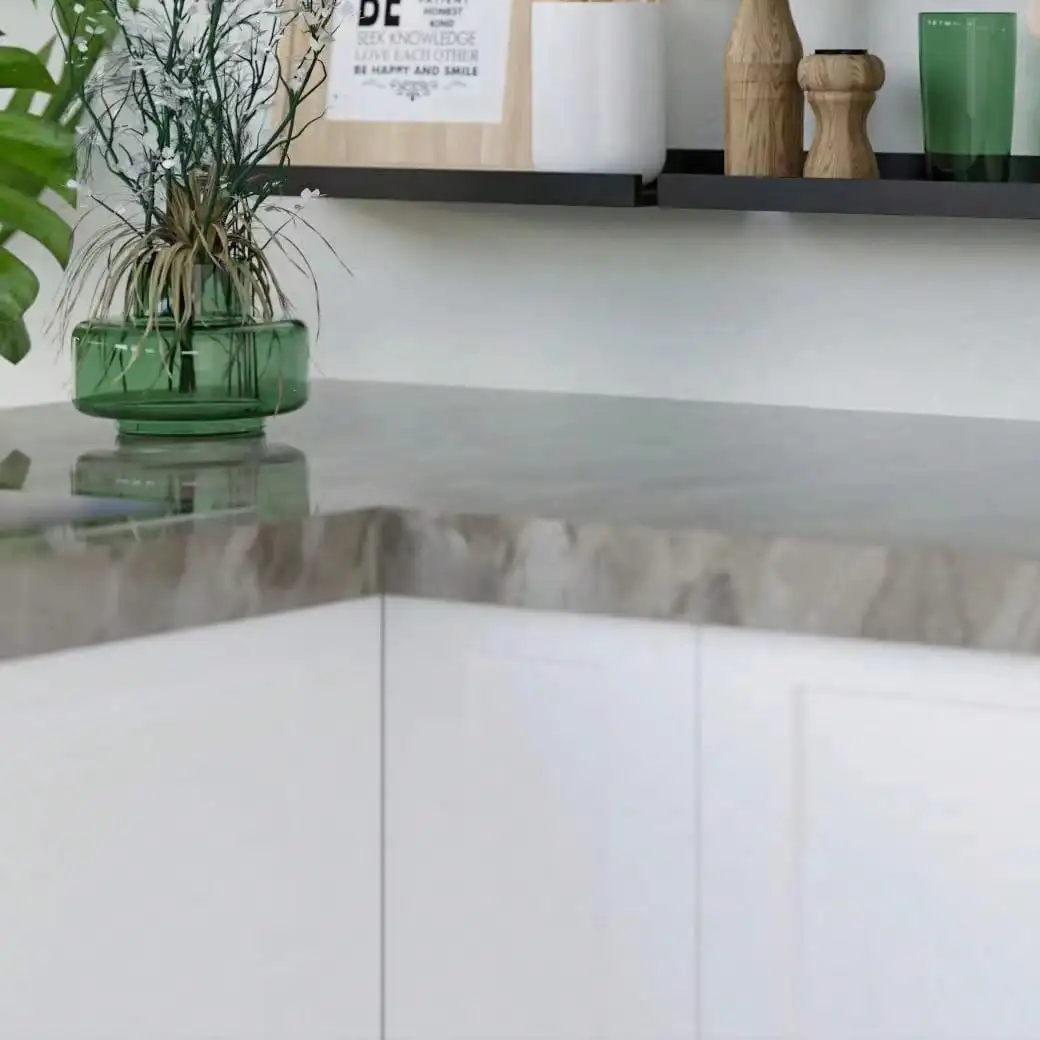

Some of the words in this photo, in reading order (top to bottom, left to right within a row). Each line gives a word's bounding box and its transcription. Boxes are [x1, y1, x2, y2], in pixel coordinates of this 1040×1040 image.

[389, 31, 476, 46] KNOWLEDGE
[354, 65, 367, 76] BE
[372, 65, 411, 76] HAPPY
[414, 66, 440, 76] AND
[444, 66, 478, 77] SMILE
